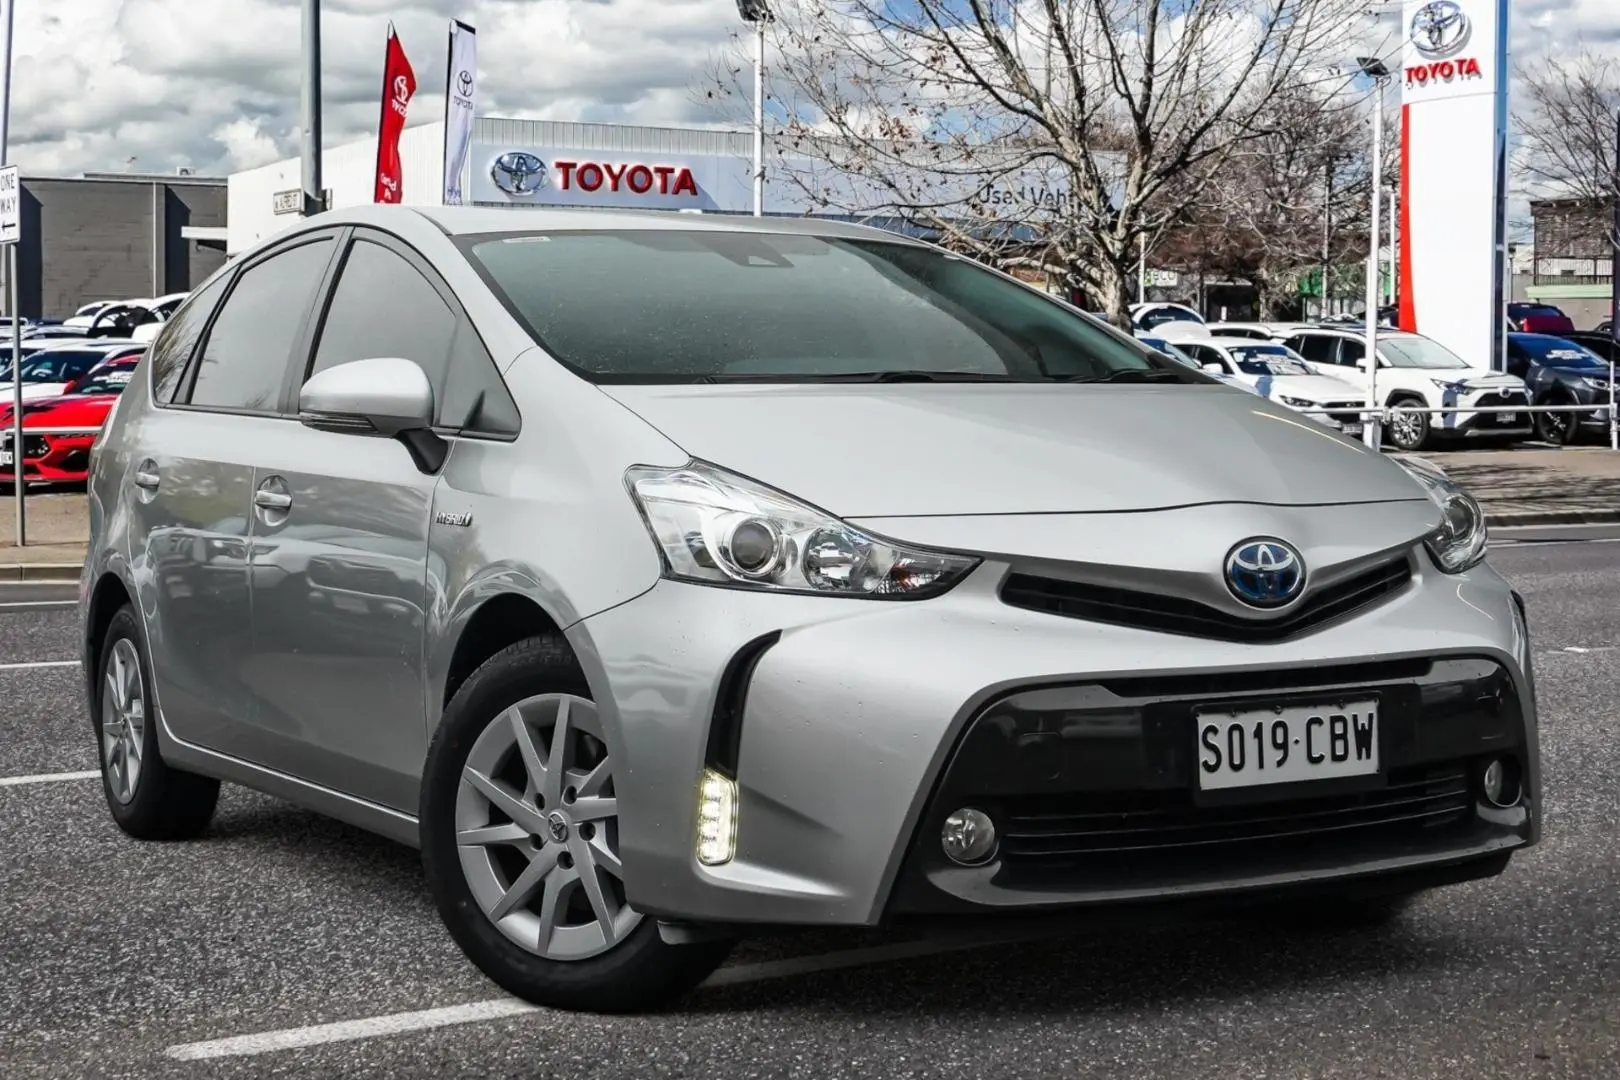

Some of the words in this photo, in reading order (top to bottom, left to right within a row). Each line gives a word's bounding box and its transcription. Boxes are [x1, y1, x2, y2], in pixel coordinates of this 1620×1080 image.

[1404, 58, 1481, 83] TOYOTA
[1, 172, 16, 192] ONE
[555, 161, 698, 196] TOYOTA
[1, 195, 17, 214] WAY
